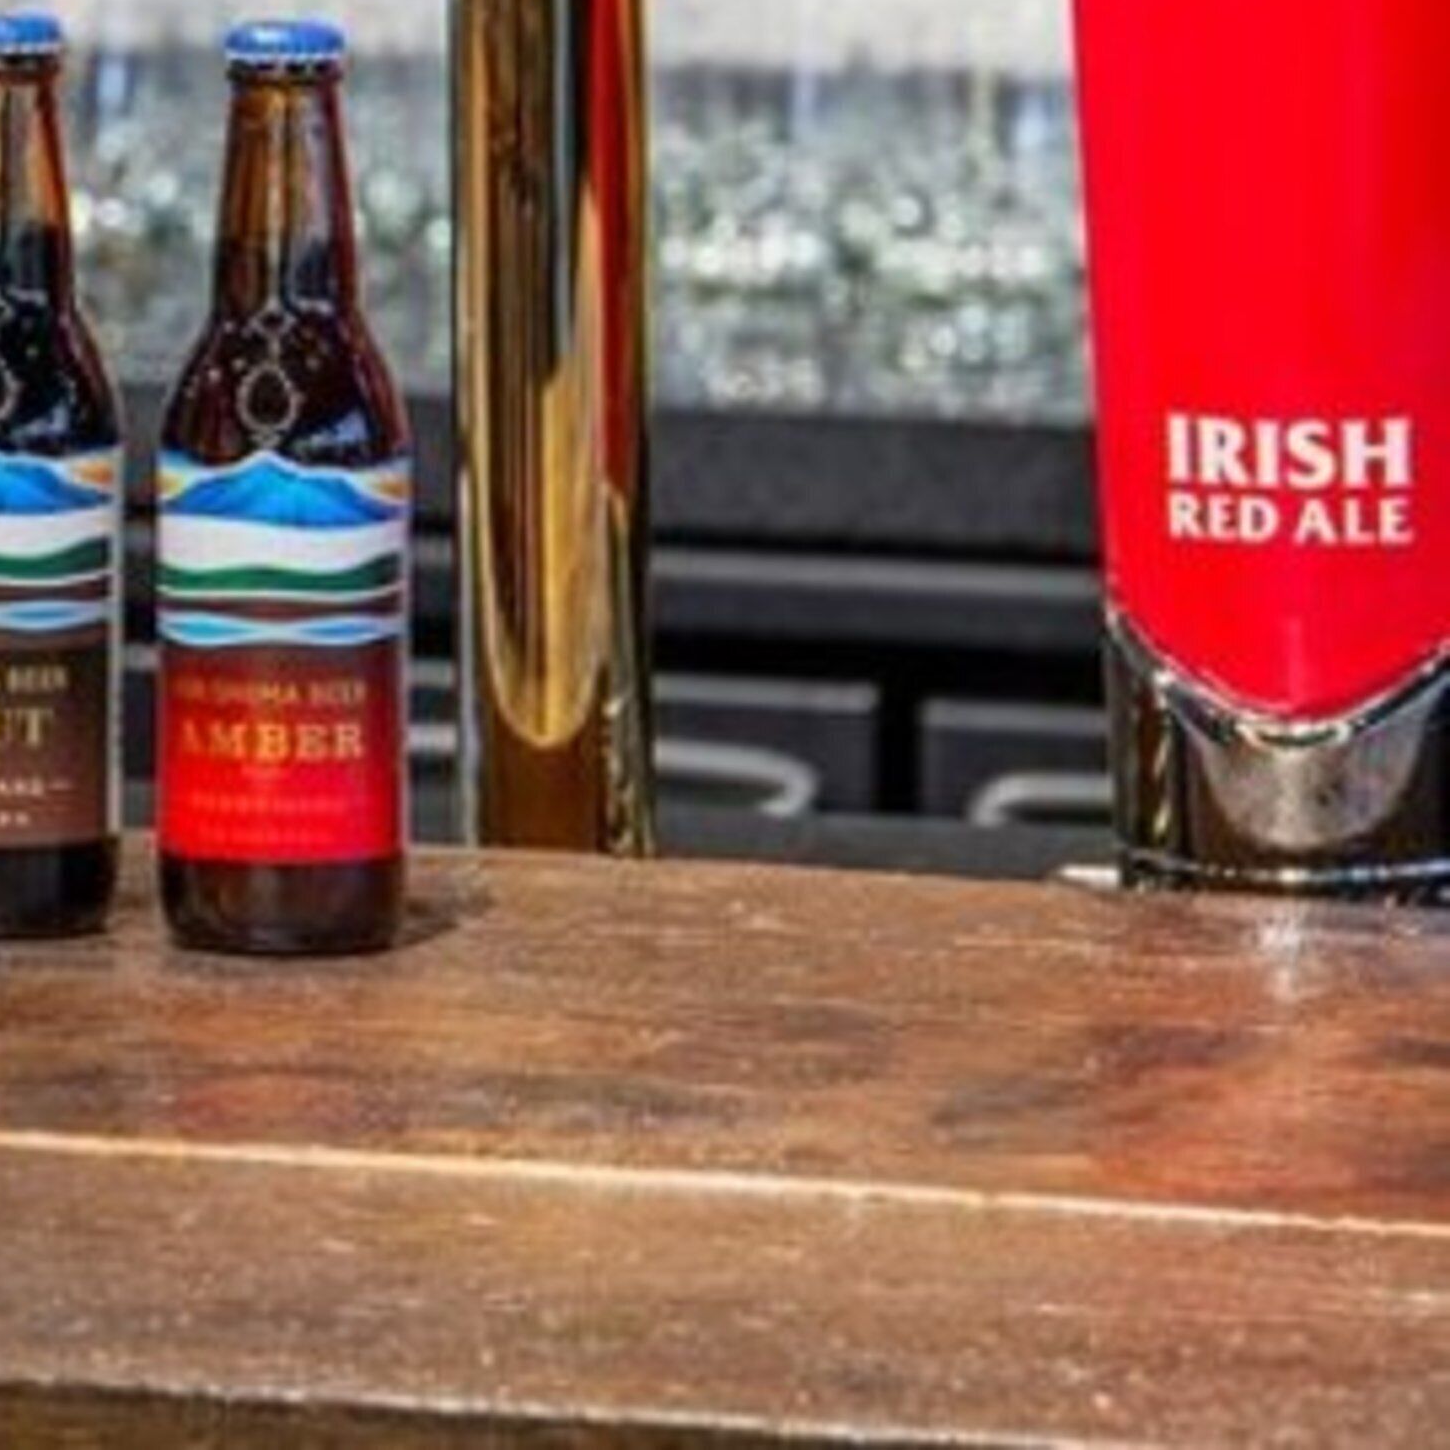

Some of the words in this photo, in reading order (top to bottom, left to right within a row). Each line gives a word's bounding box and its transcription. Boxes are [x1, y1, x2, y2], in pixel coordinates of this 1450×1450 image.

[1167, 412, 1411, 490] IRISH
[1167, 492, 1279, 542] RED
[1294, 496, 1414, 545] ALE
[182, 718, 365, 764] AMBER
